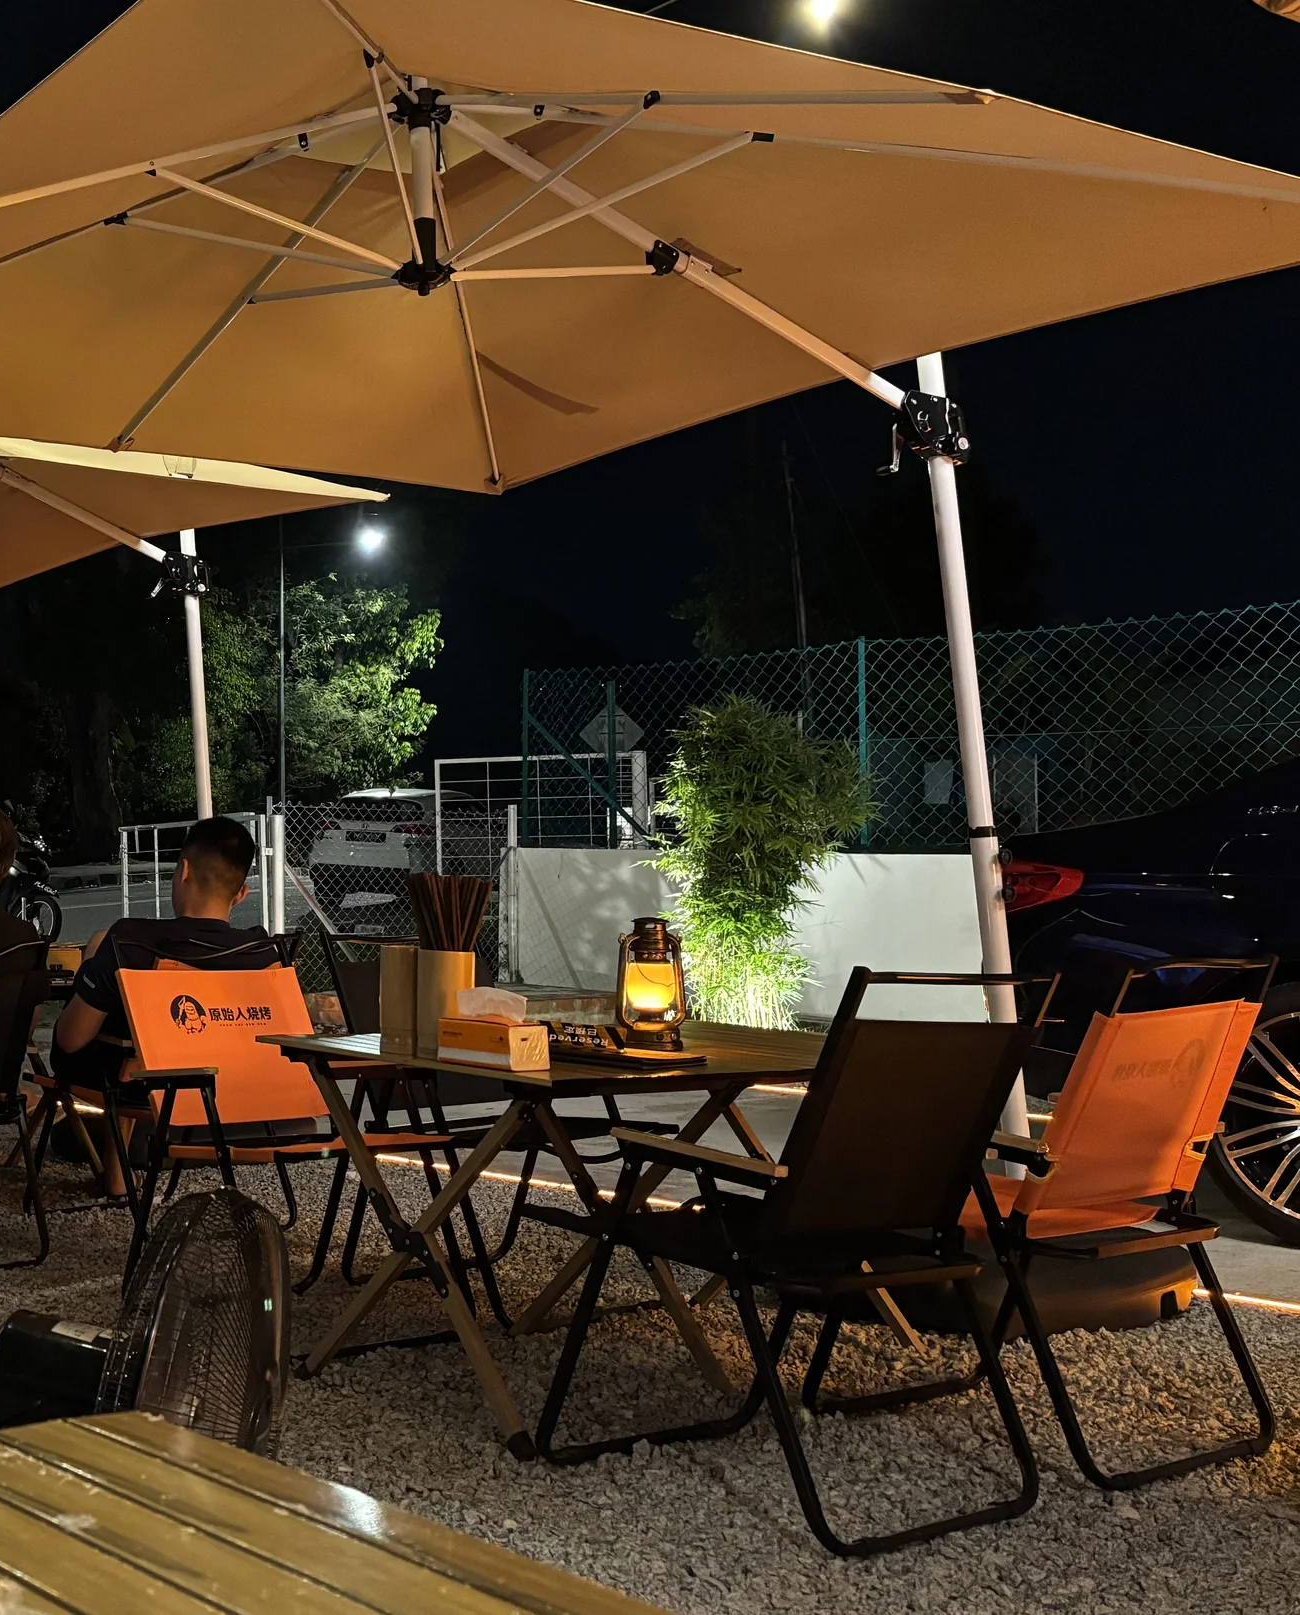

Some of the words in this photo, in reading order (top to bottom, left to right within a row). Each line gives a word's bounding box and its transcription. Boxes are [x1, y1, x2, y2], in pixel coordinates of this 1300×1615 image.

[208, 1006, 272, 1022] 原始人烧烤
[548, 1033, 609, 1047] Reserved
